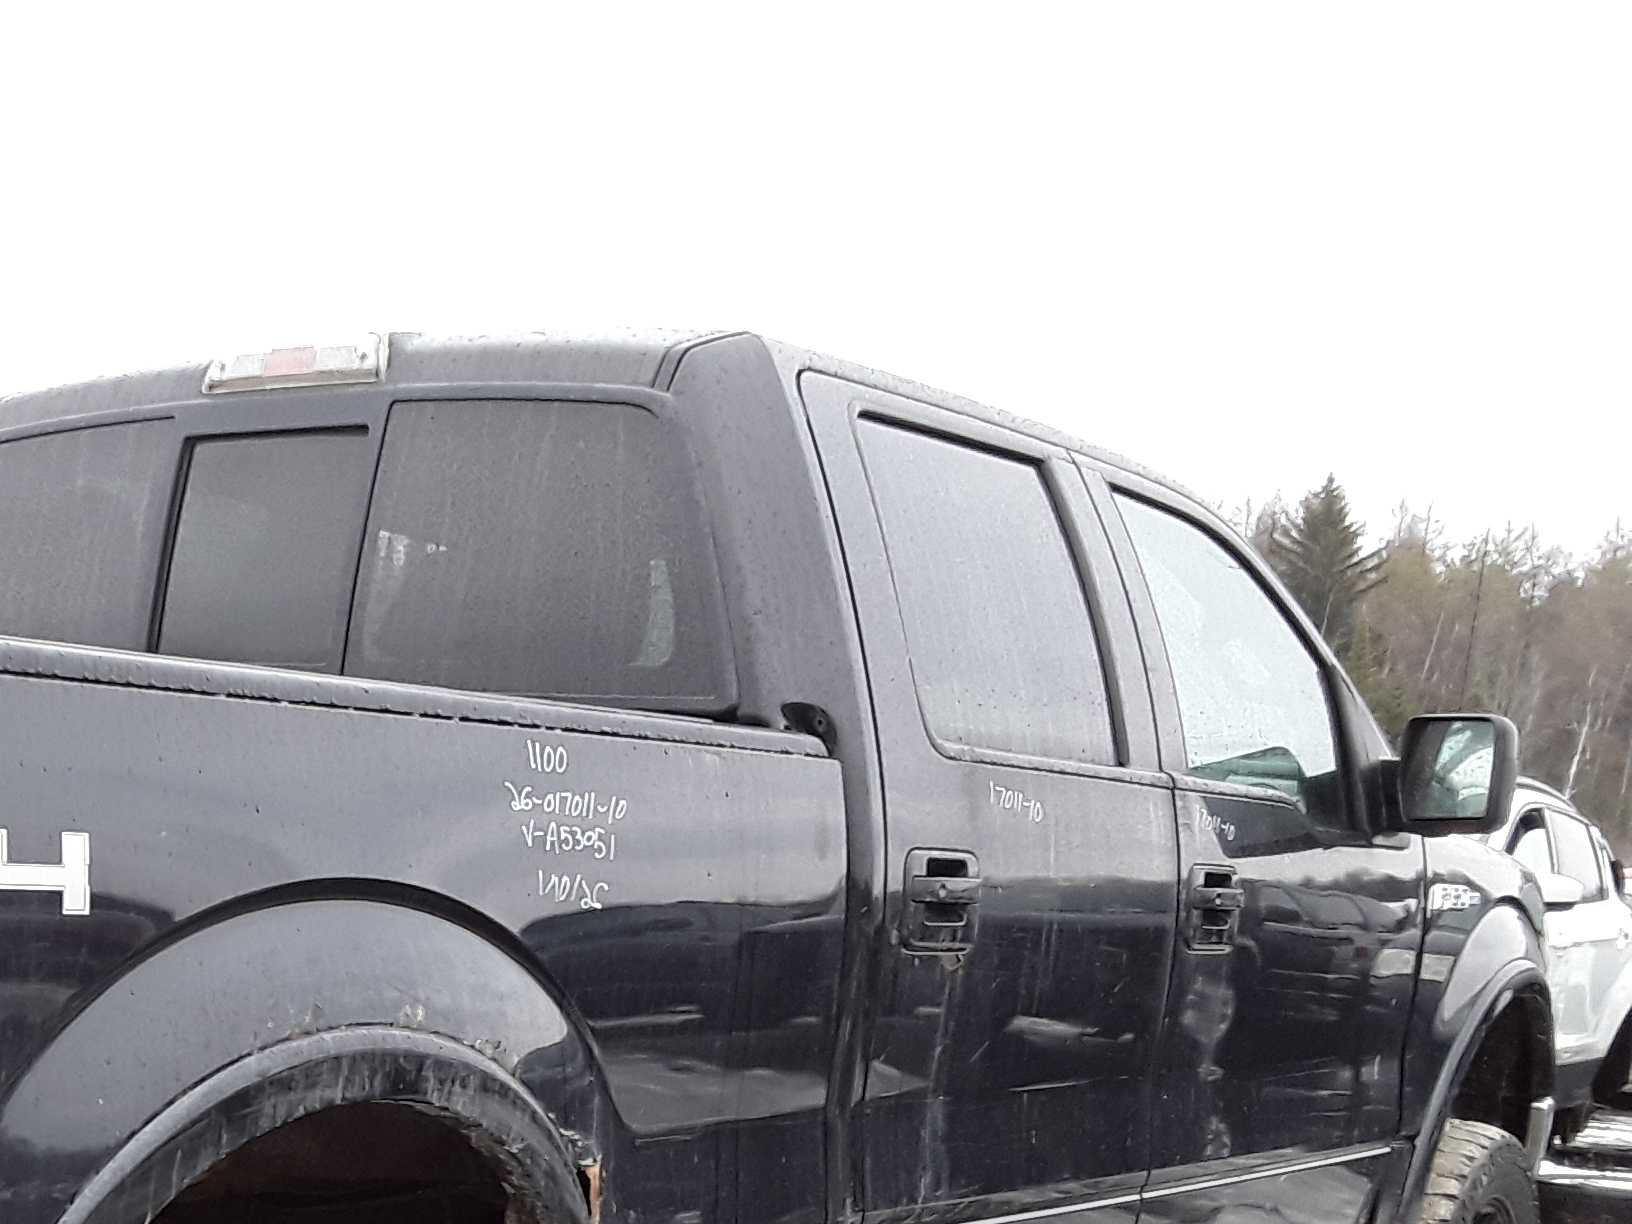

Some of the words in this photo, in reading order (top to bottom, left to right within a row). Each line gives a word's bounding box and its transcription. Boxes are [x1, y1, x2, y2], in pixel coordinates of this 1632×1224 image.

[526, 739, 568, 773] 1100
[504, 781, 627, 825] 26-017011-10
[989, 779, 1044, 822] 17011-10
[521, 819, 616, 861] V-A53051
